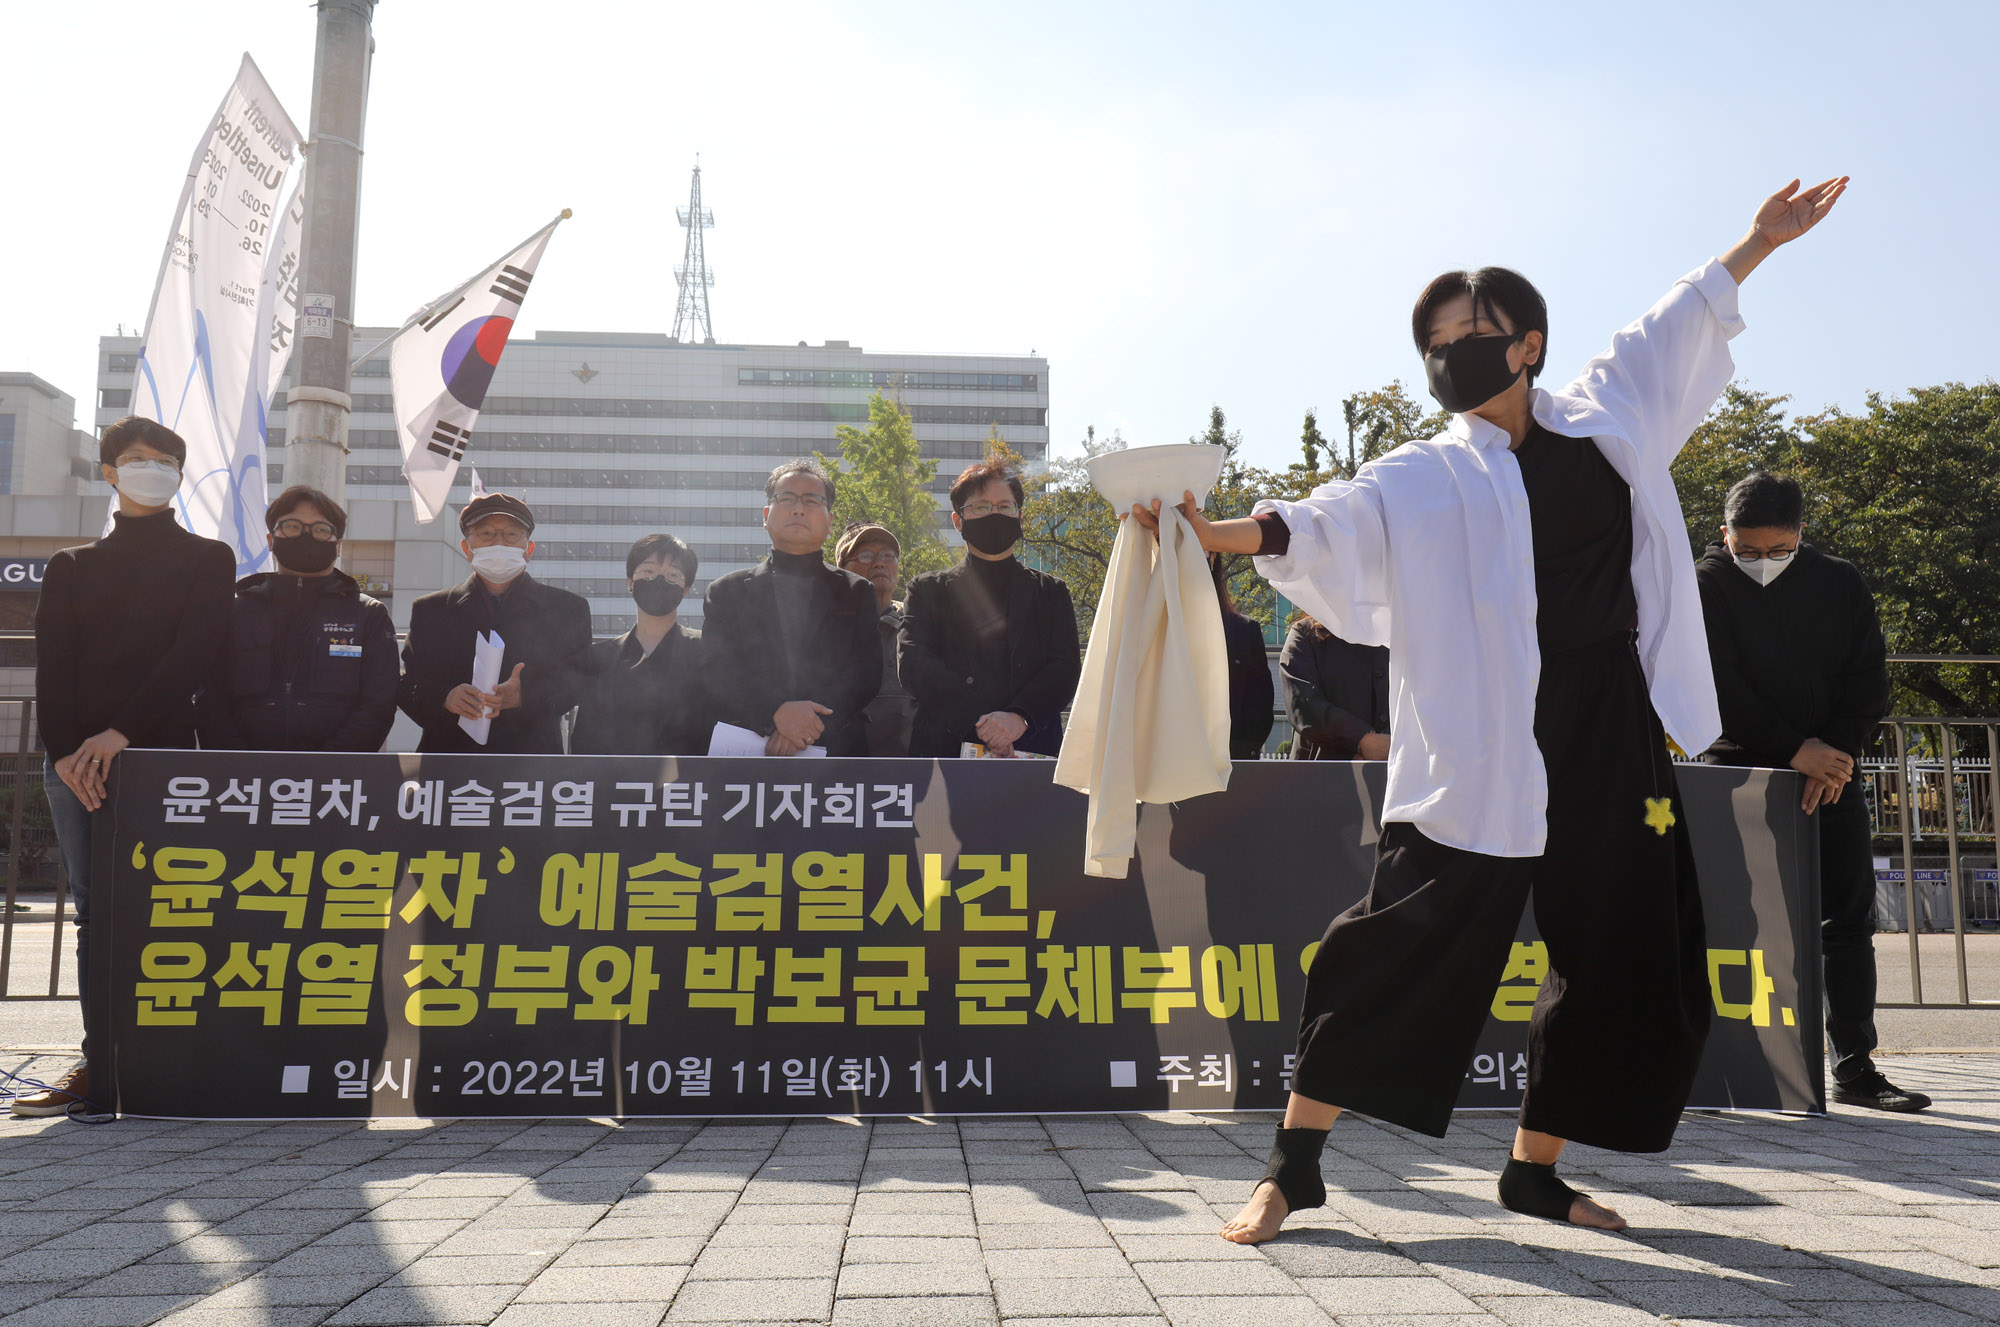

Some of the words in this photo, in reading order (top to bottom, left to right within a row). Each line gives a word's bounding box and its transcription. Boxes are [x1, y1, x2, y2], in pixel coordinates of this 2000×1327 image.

[0, 563, 47, 583] GU
[163, 777, 379, 830] 윤석열차,
[397, 779, 595, 827] 예술검열
[610, 782, 708, 827] 규탄
[722, 782, 914, 828] 기자회견
[539, 851, 1056, 939] 예술검열사건,
[1916, 872, 1932, 880] LINE
[135, 942, 378, 1026] 윤석열
[403, 943, 659, 1027] 정부와
[685, 946, 929, 1026] 박보균
[955, 943, 1280, 1025] 문체부에
[334, 1058, 411, 1099] 일시
[461, 1057, 604, 1097] 2022년
[625, 1056, 711, 1097] 10월
[732, 1055, 890, 1098] 11일(화)
[909, 1057, 993, 1095] 11시
[1156, 1053, 1232, 1093] 주최
